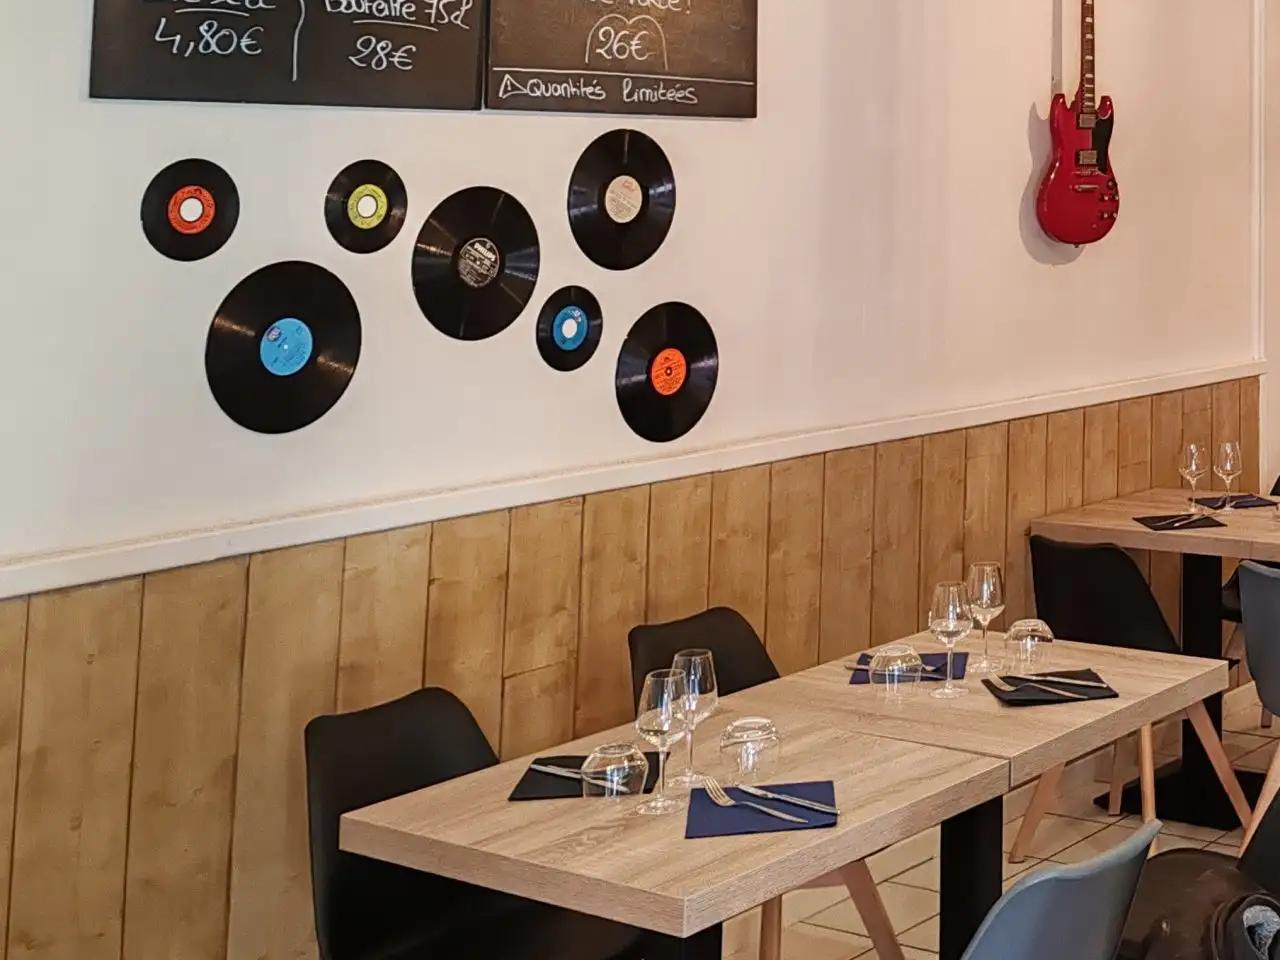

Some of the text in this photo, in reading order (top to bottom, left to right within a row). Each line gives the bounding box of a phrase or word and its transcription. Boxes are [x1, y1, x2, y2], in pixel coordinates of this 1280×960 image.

[154, 17, 264, 57] 4,80€
[348, 36, 417, 71] 28€
[596, 26, 652, 60] 26€
[526, 76, 606, 100] Quantités
